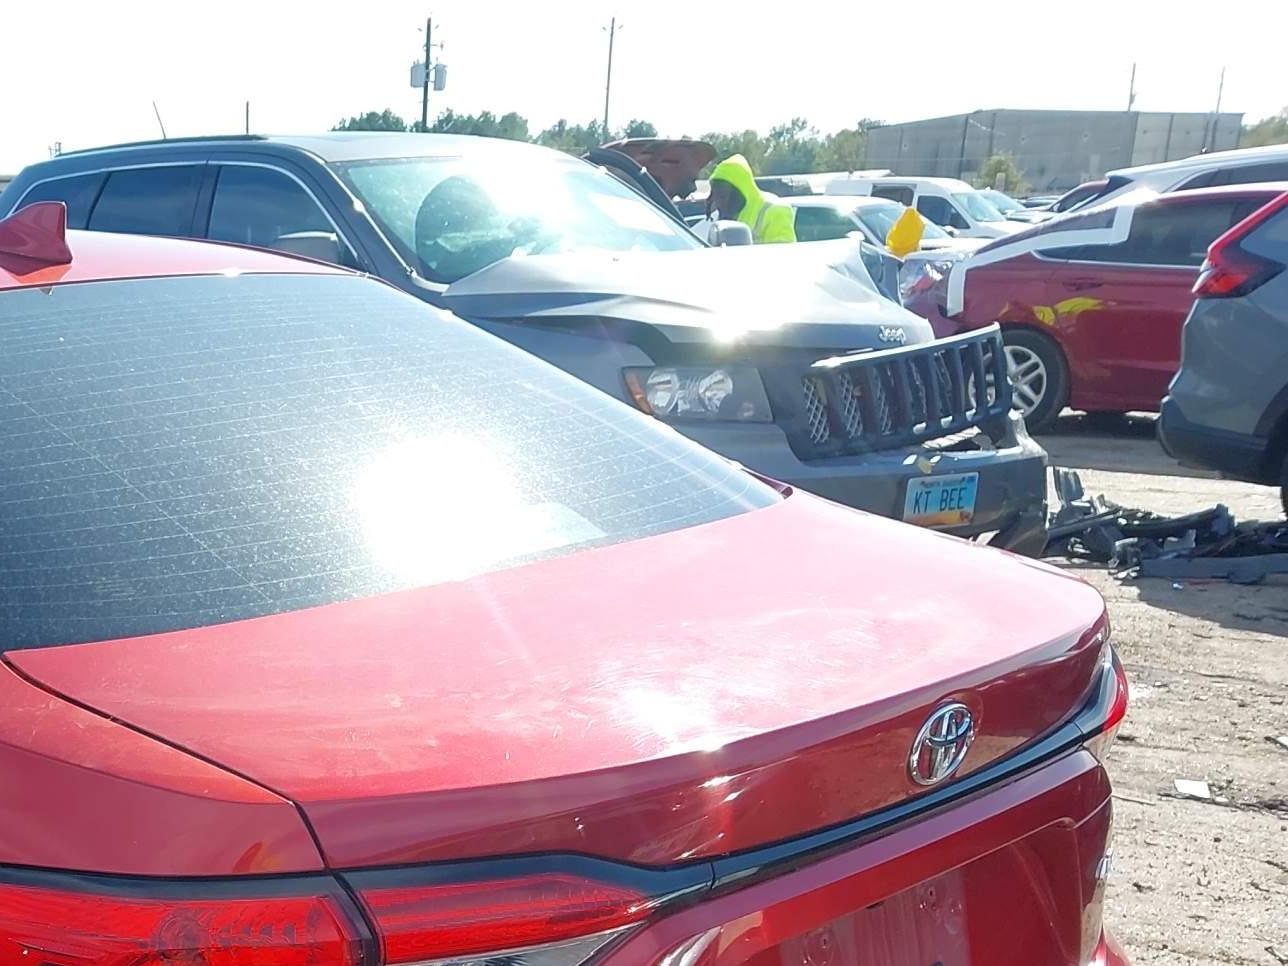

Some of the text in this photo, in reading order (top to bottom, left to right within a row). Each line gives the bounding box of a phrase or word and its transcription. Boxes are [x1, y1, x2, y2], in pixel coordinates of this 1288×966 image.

[879, 325, 906, 345] Jeep
[913, 487, 967, 514] KT BEE
